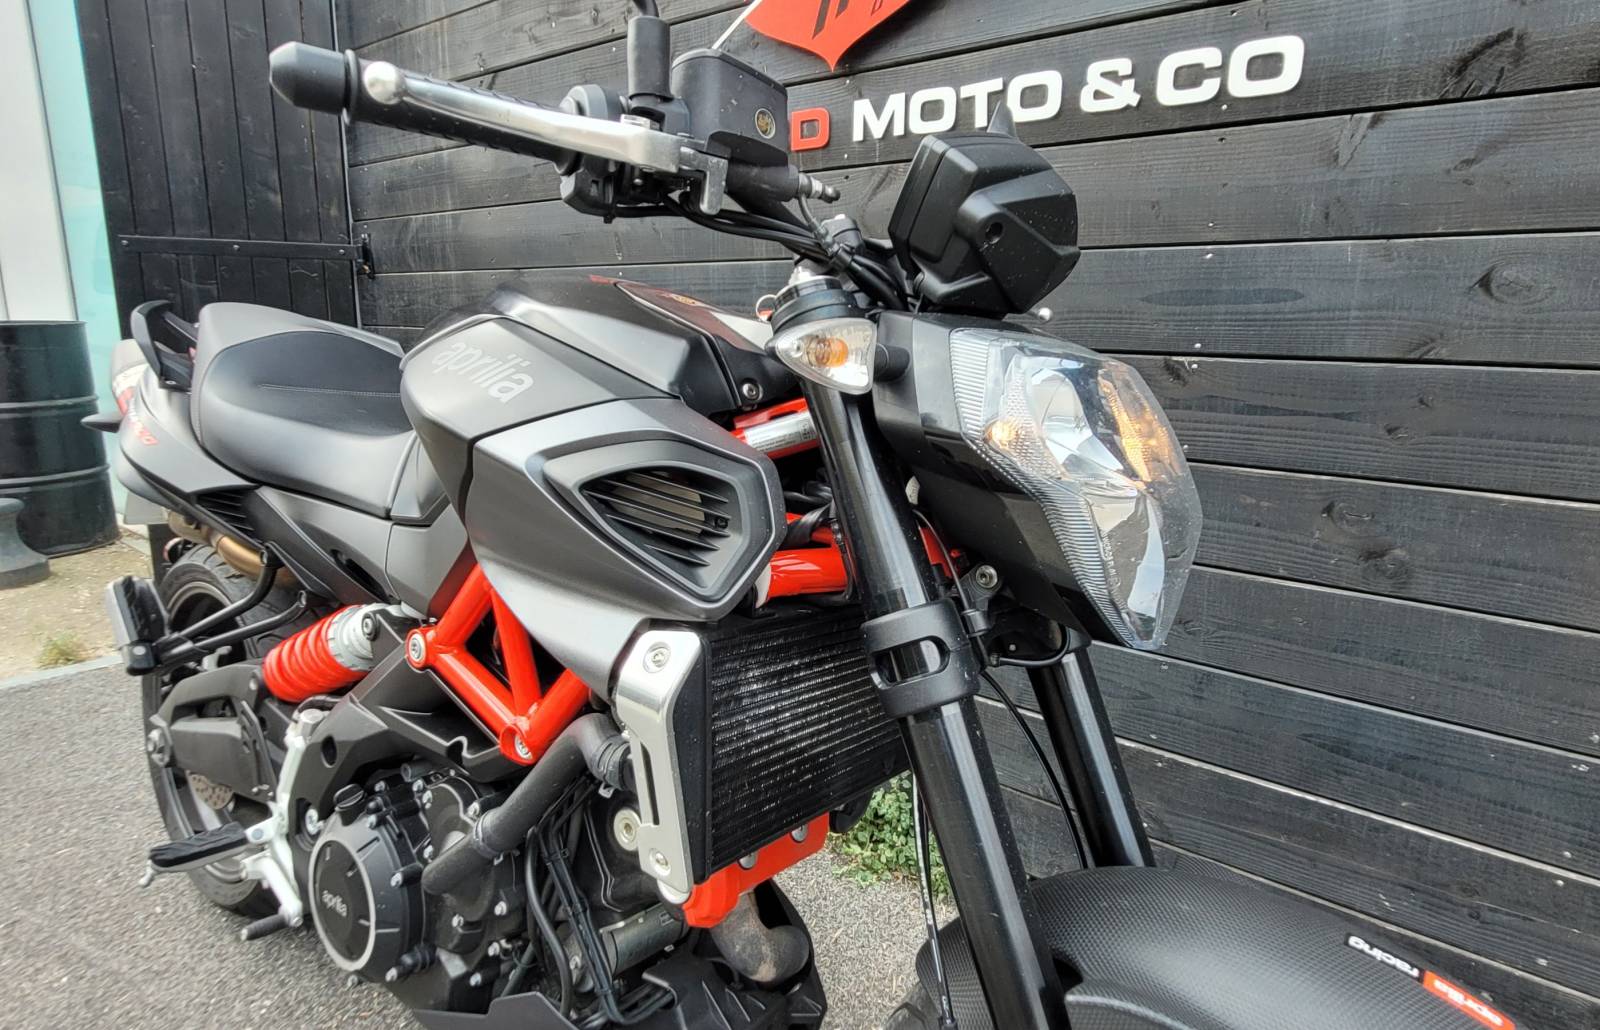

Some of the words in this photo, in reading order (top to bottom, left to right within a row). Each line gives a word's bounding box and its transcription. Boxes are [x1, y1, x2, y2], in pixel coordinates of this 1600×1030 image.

[852, 70, 1063, 142] MOTO
[1080, 58, 1141, 112] &
[1156, 35, 1305, 106] CO
[431, 342, 534, 403] aprilia
[322, 890, 348, 917] aprilia
[1348, 935, 1421, 978] racing
